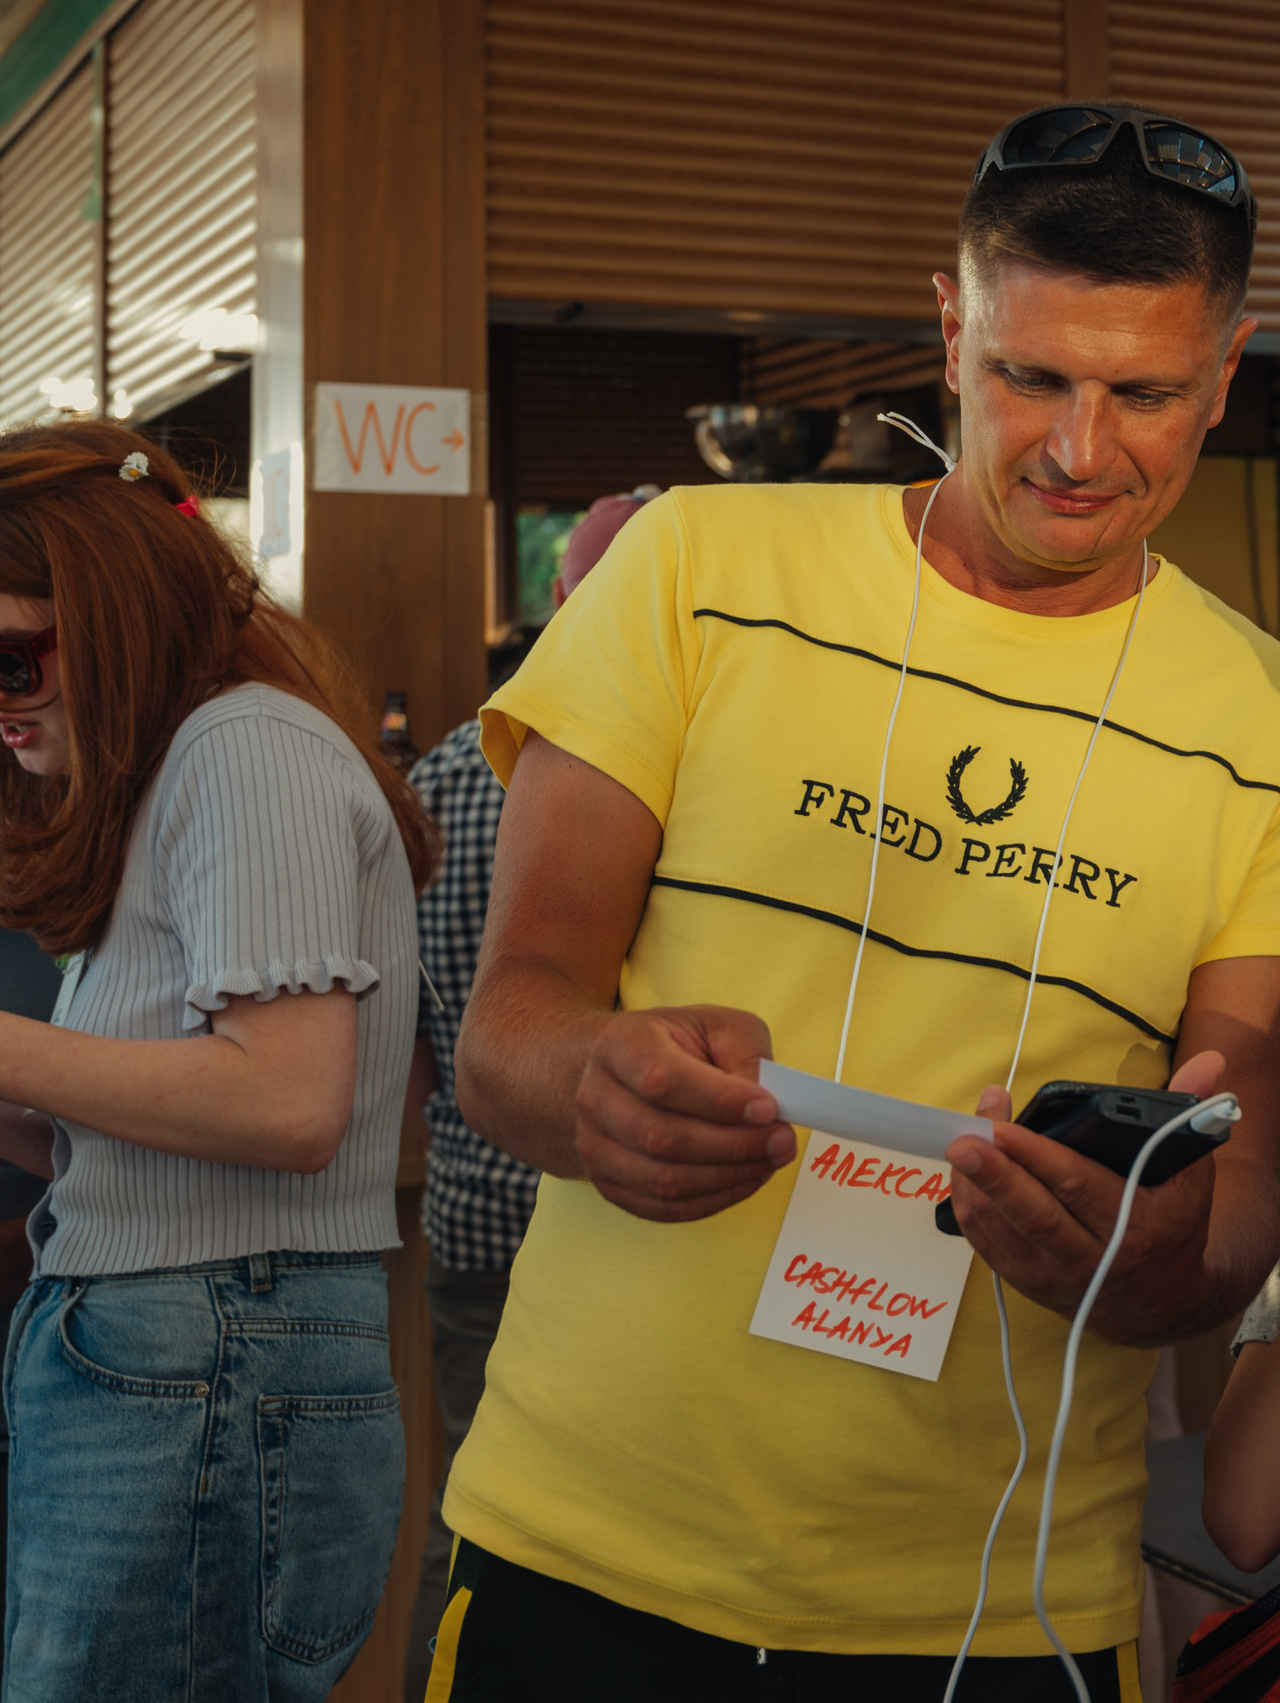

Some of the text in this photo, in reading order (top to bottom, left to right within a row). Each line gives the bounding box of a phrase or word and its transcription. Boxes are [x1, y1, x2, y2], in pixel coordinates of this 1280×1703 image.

[334, 401, 440, 477] WC
[794, 779, 1138, 908] FRED PERRY
[784, 1254, 949, 1320] CASHFLOW
[791, 1301, 912, 1358] ALANYA
